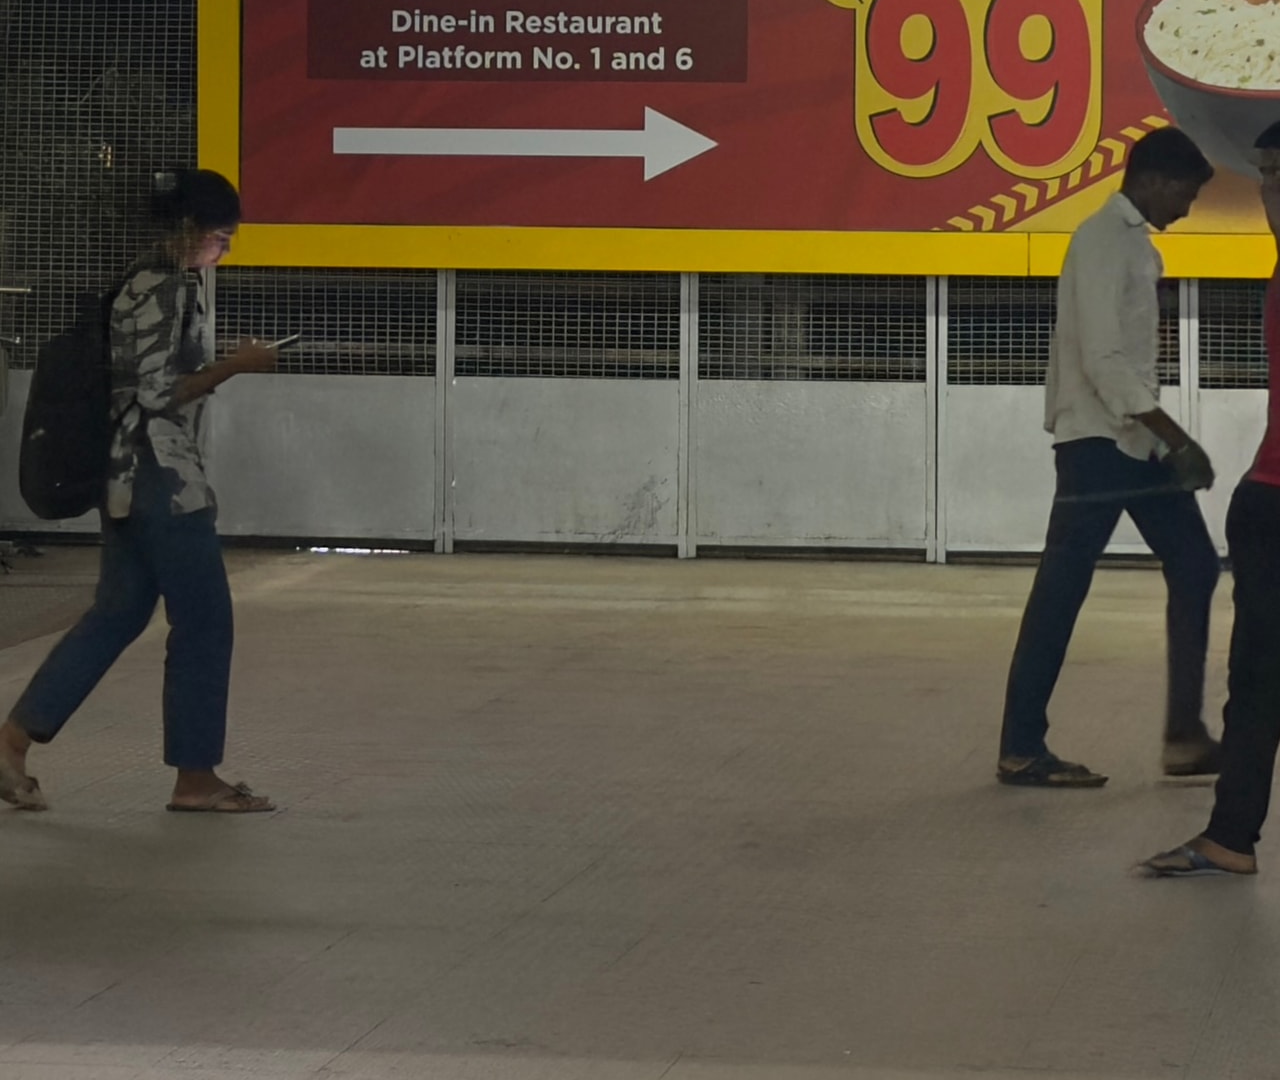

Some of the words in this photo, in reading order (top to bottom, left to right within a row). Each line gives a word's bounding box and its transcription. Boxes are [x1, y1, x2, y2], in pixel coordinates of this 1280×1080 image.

[391, 9, 496, 35] Dine-in
[505, 9, 663, 36] Restaurant
[360, 46, 388, 70] at
[397, 44, 523, 70] Platform
[532, 47, 581, 71] No.
[590, 47, 602, 70] 1
[611, 46, 665, 71] and
[674, 48, 693, 70] 6
